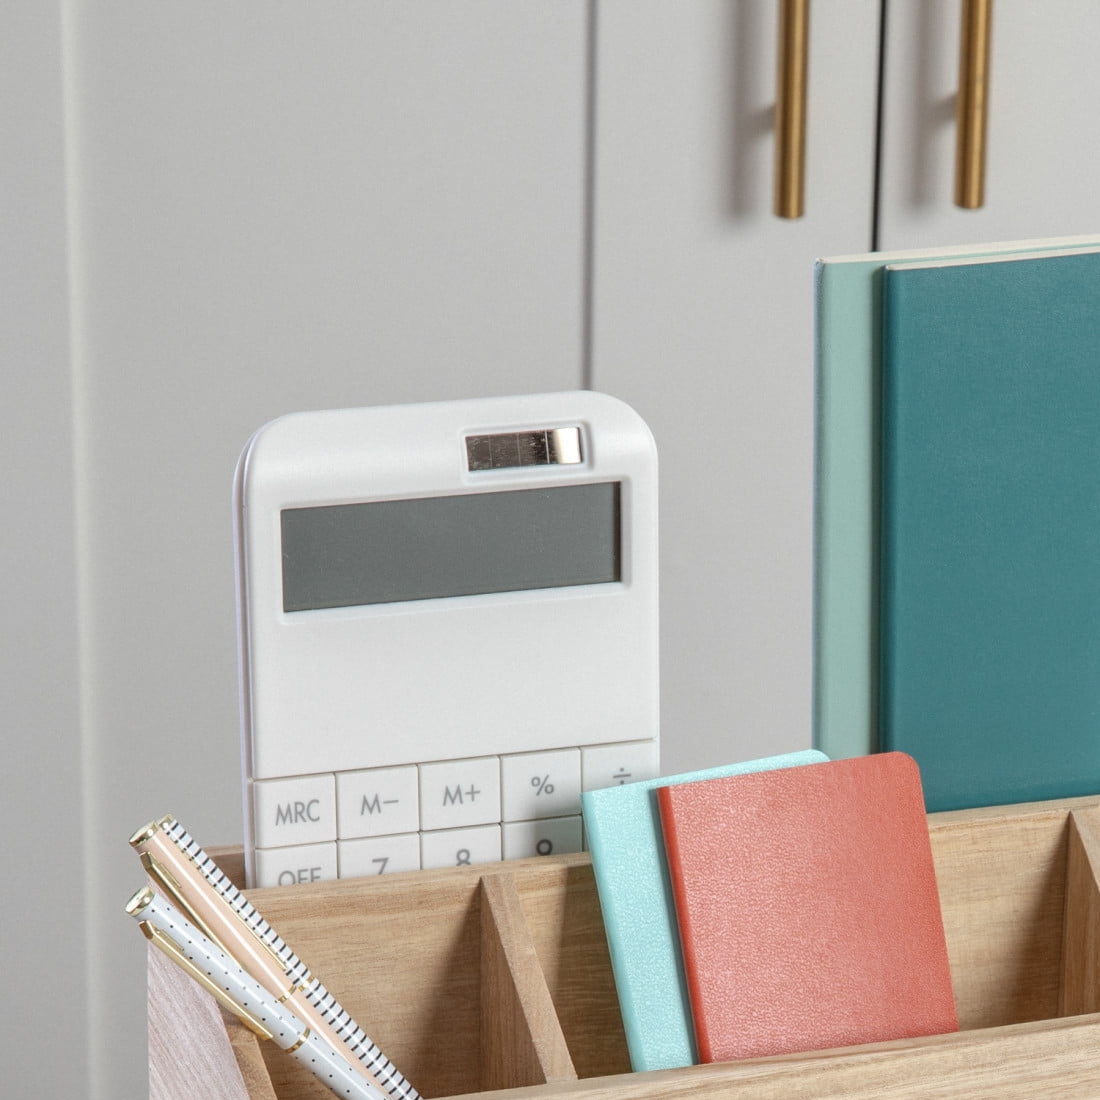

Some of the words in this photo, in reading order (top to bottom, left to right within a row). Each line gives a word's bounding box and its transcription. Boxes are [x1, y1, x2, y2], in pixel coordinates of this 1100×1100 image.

[275, 799, 320, 826] MRC
[443, 784, 481, 806] M+
[531, 775, 554, 796] %
[278, 867, 322, 886] OFF
[372, 857, 389, 875] 7
[456, 849, 472, 866] 8
